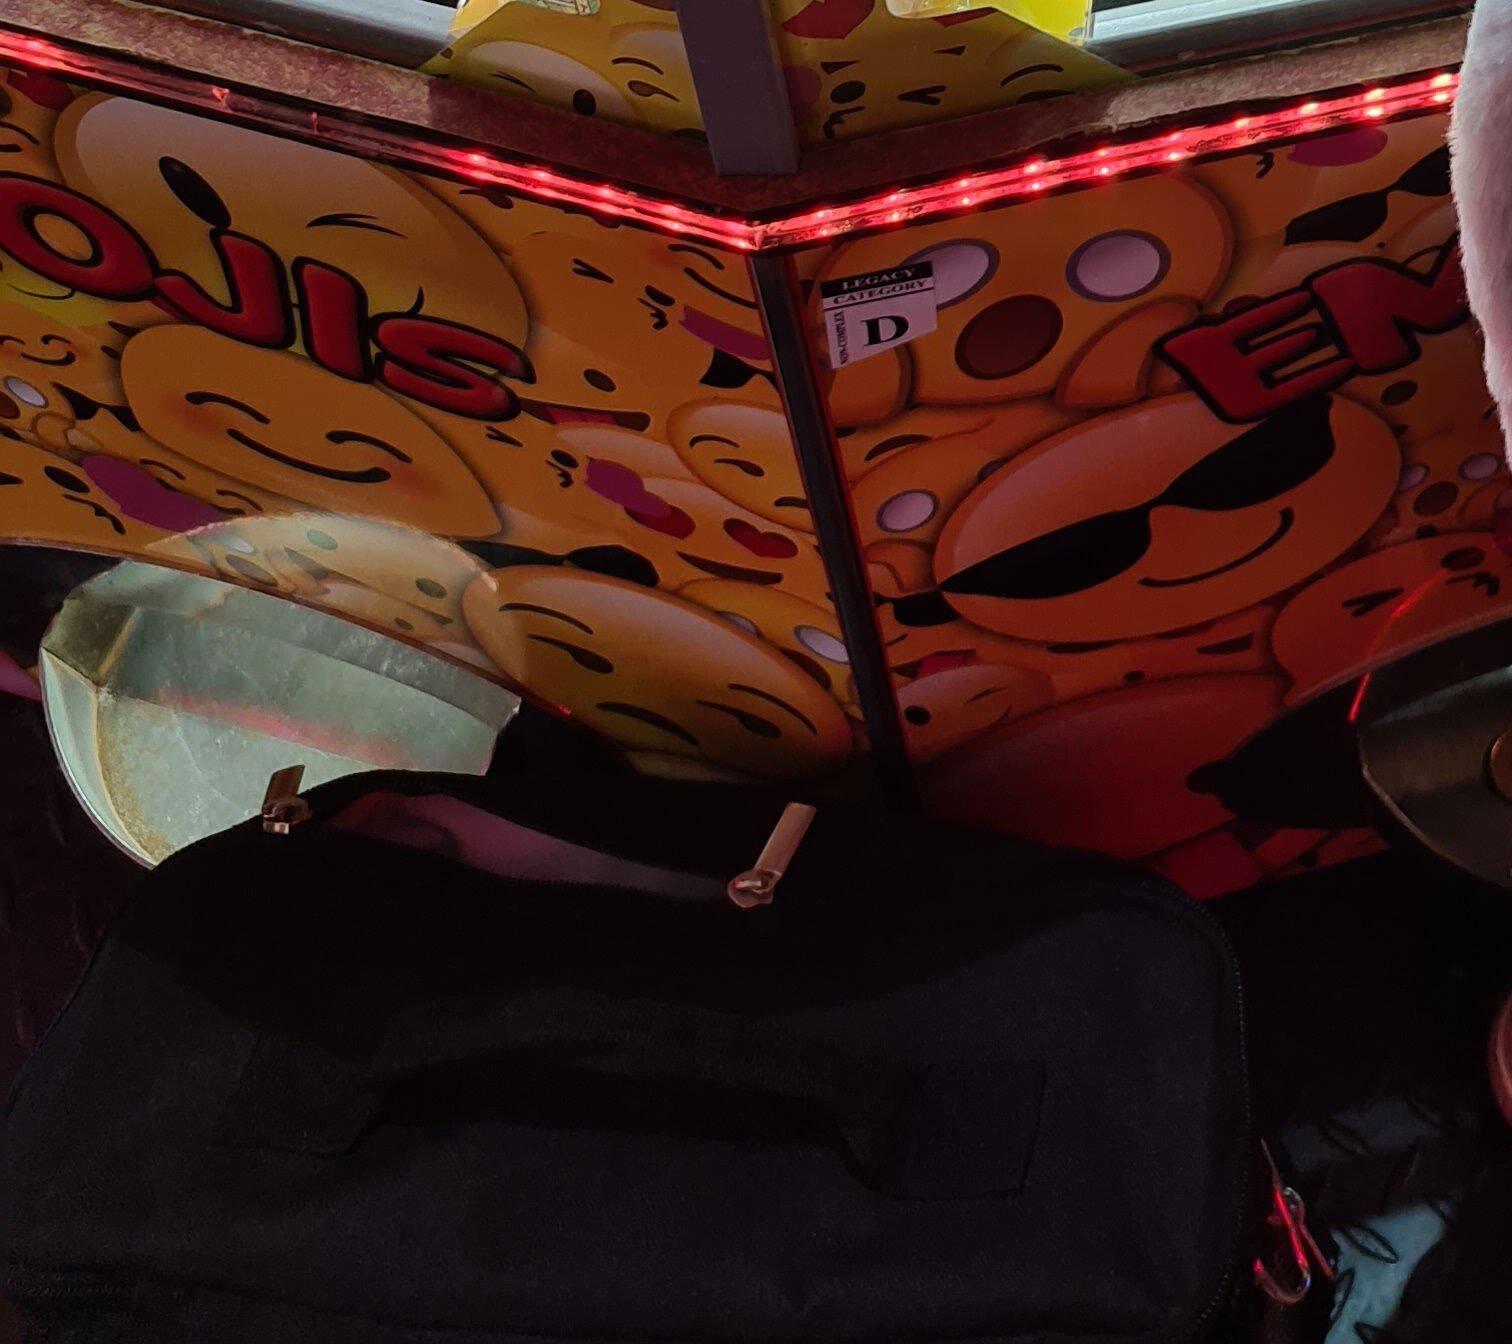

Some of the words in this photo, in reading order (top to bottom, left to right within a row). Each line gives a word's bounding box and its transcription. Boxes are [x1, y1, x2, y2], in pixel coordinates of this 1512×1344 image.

[833, 279, 929, 304] CATEGORY
[843, 267, 916, 291] LEGACY
[860, 315, 909, 347] D
